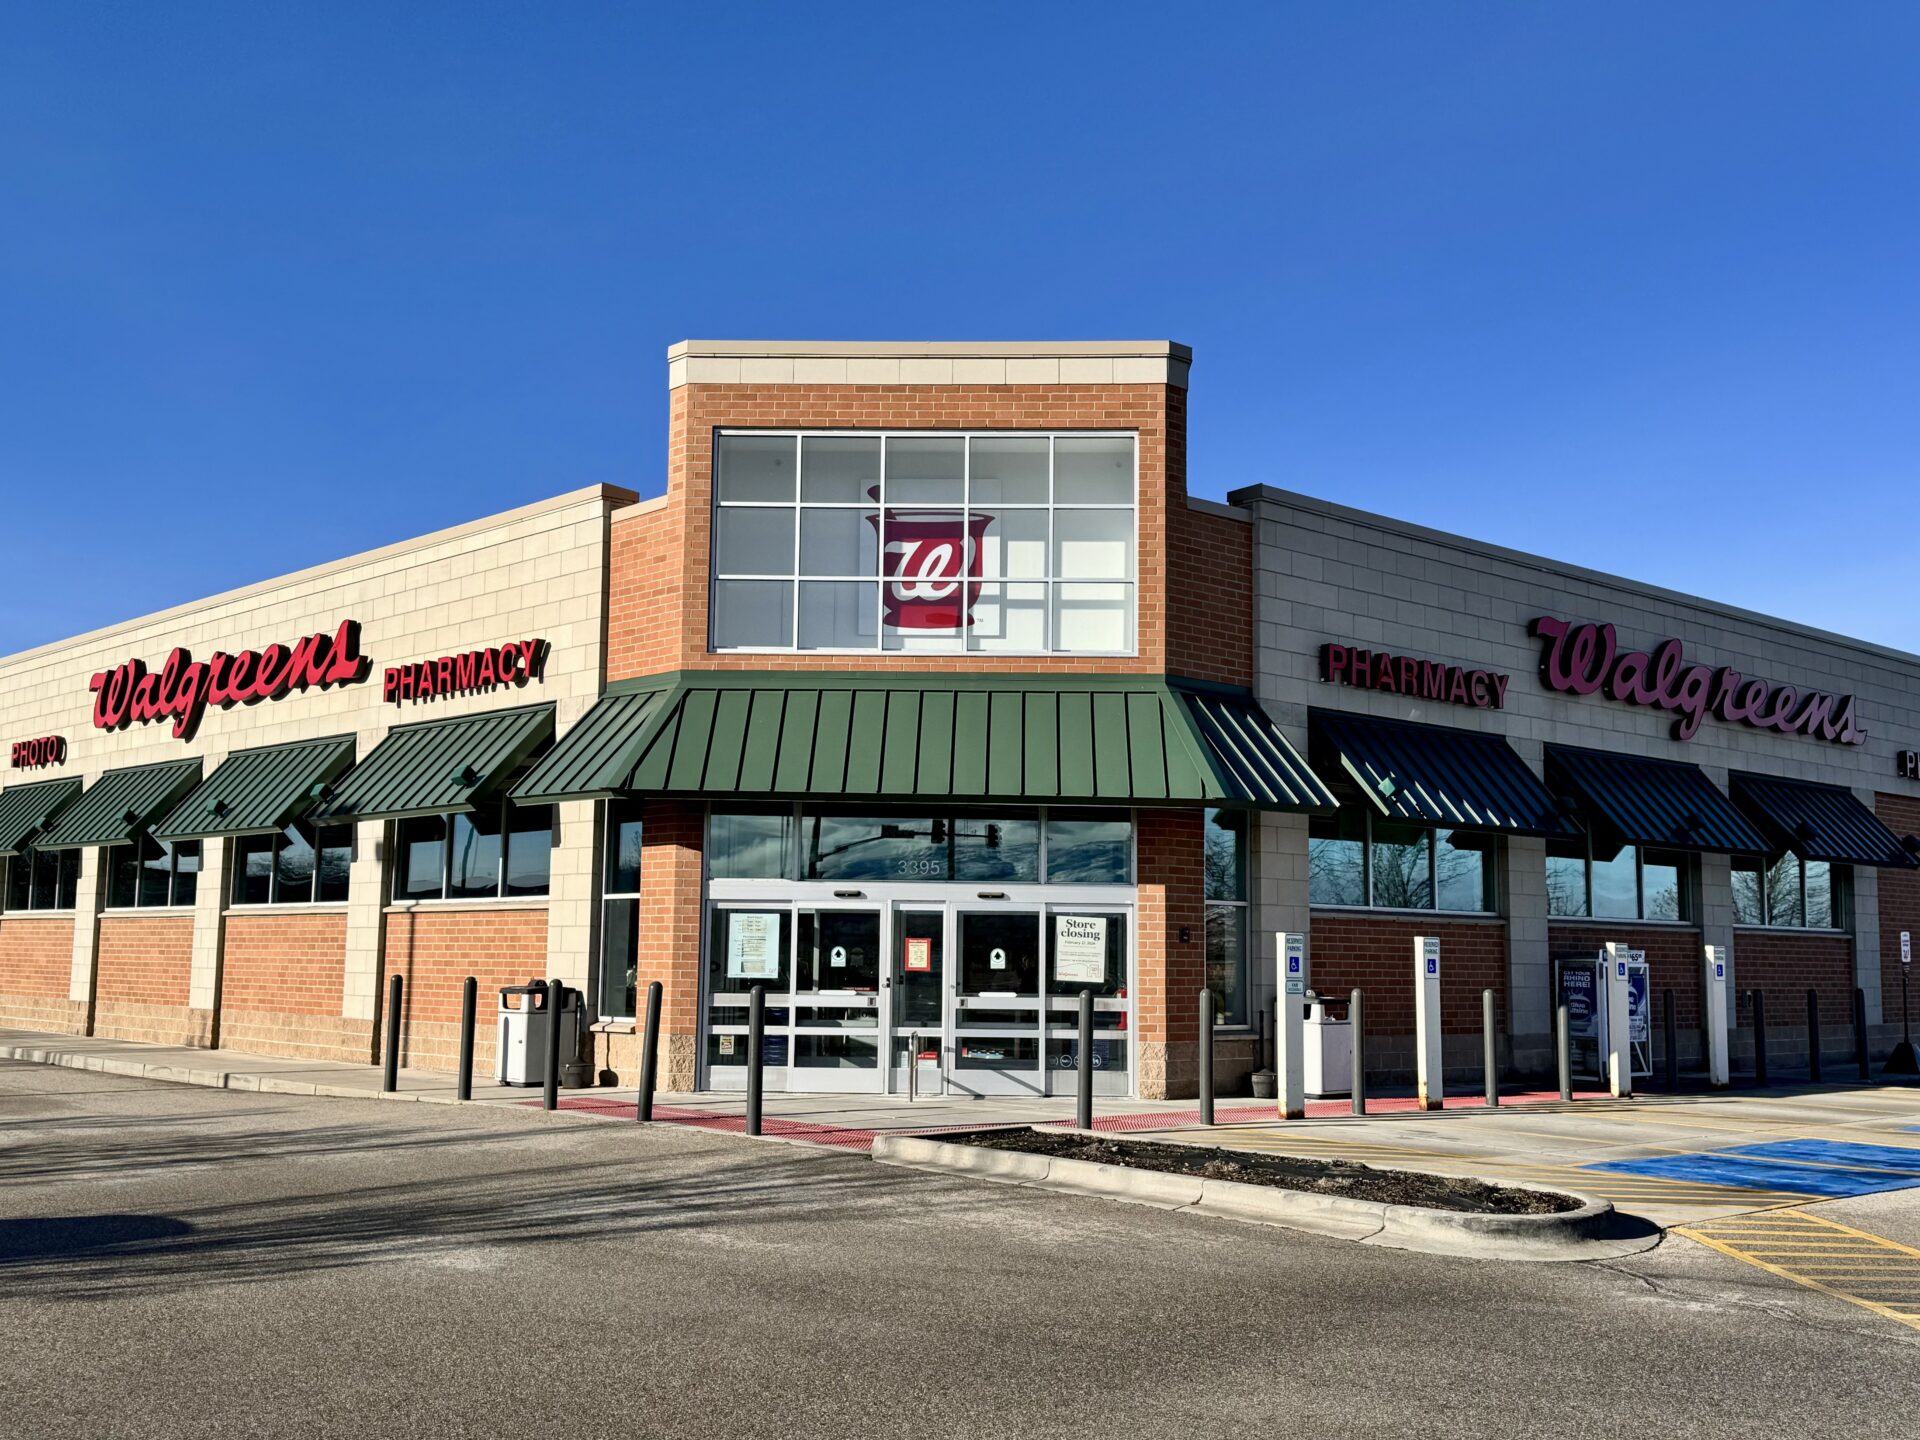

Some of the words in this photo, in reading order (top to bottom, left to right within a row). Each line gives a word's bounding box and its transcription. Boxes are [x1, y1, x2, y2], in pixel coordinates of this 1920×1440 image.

[89, 619, 369, 740] Walgreens
[383, 638, 547, 704] PHARMACY
[1322, 642, 1510, 710] PHARMACY
[1532, 616, 1867, 744] Walgreens
[11, 735, 62, 768] PHOTO
[898, 860, 940, 875] 3395
[1060, 928, 1101, 941] closing
[1065, 918, 1096, 929] Store
